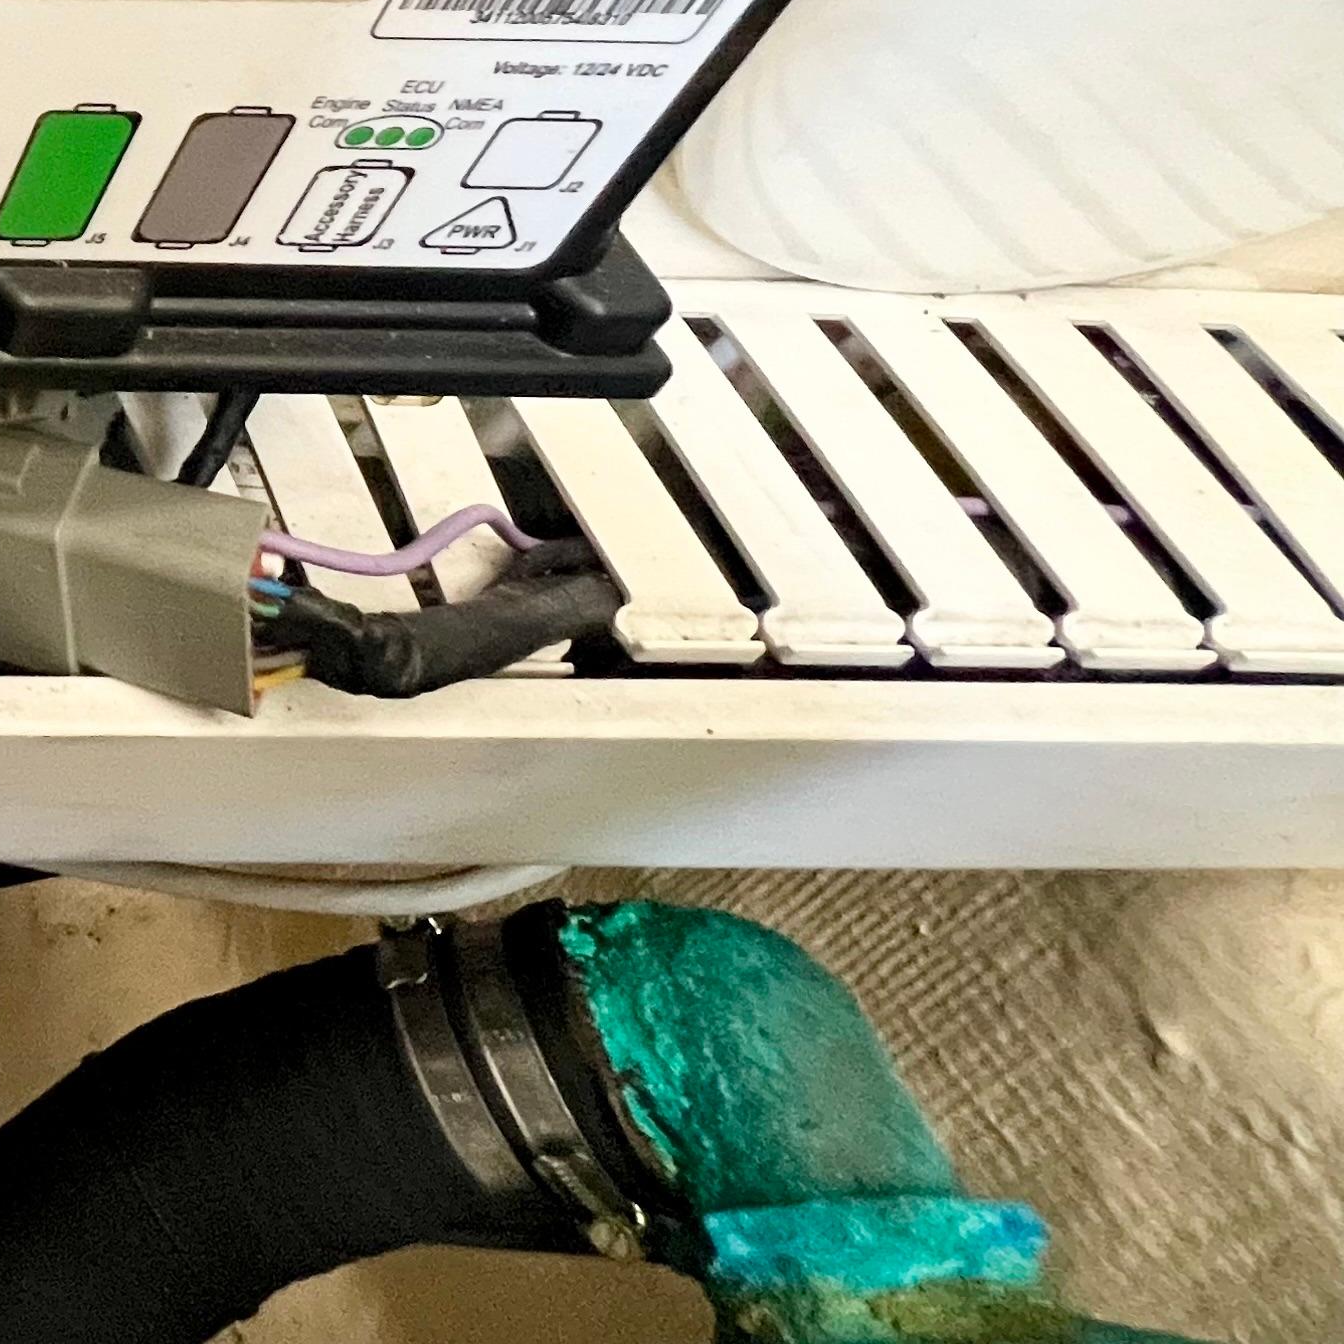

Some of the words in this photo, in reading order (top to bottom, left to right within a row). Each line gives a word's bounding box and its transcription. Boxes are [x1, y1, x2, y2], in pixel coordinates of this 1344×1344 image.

[493, 61, 566, 78] Voltage:
[573, 62, 620, 76] 12/24
[625, 63, 669, 78] VDC
[400, 79, 445, 94] ECU
[312, 96, 371, 112] Engine
[382, 98, 437, 113] Status
[448, 98, 505, 111] NMEA
[309, 115, 348, 129] Com
[444, 117, 486, 130] Com
[559, 180, 585, 194] J2
[305, 168, 368, 242] Accessory
[333, 187, 386, 242] Harness
[85, 232, 107, 245] J5
[447, 223, 502, 240] PWR
[229, 235, 251, 248] J4
[372, 238, 394, 251] J3
[515, 240, 537, 253] J1
